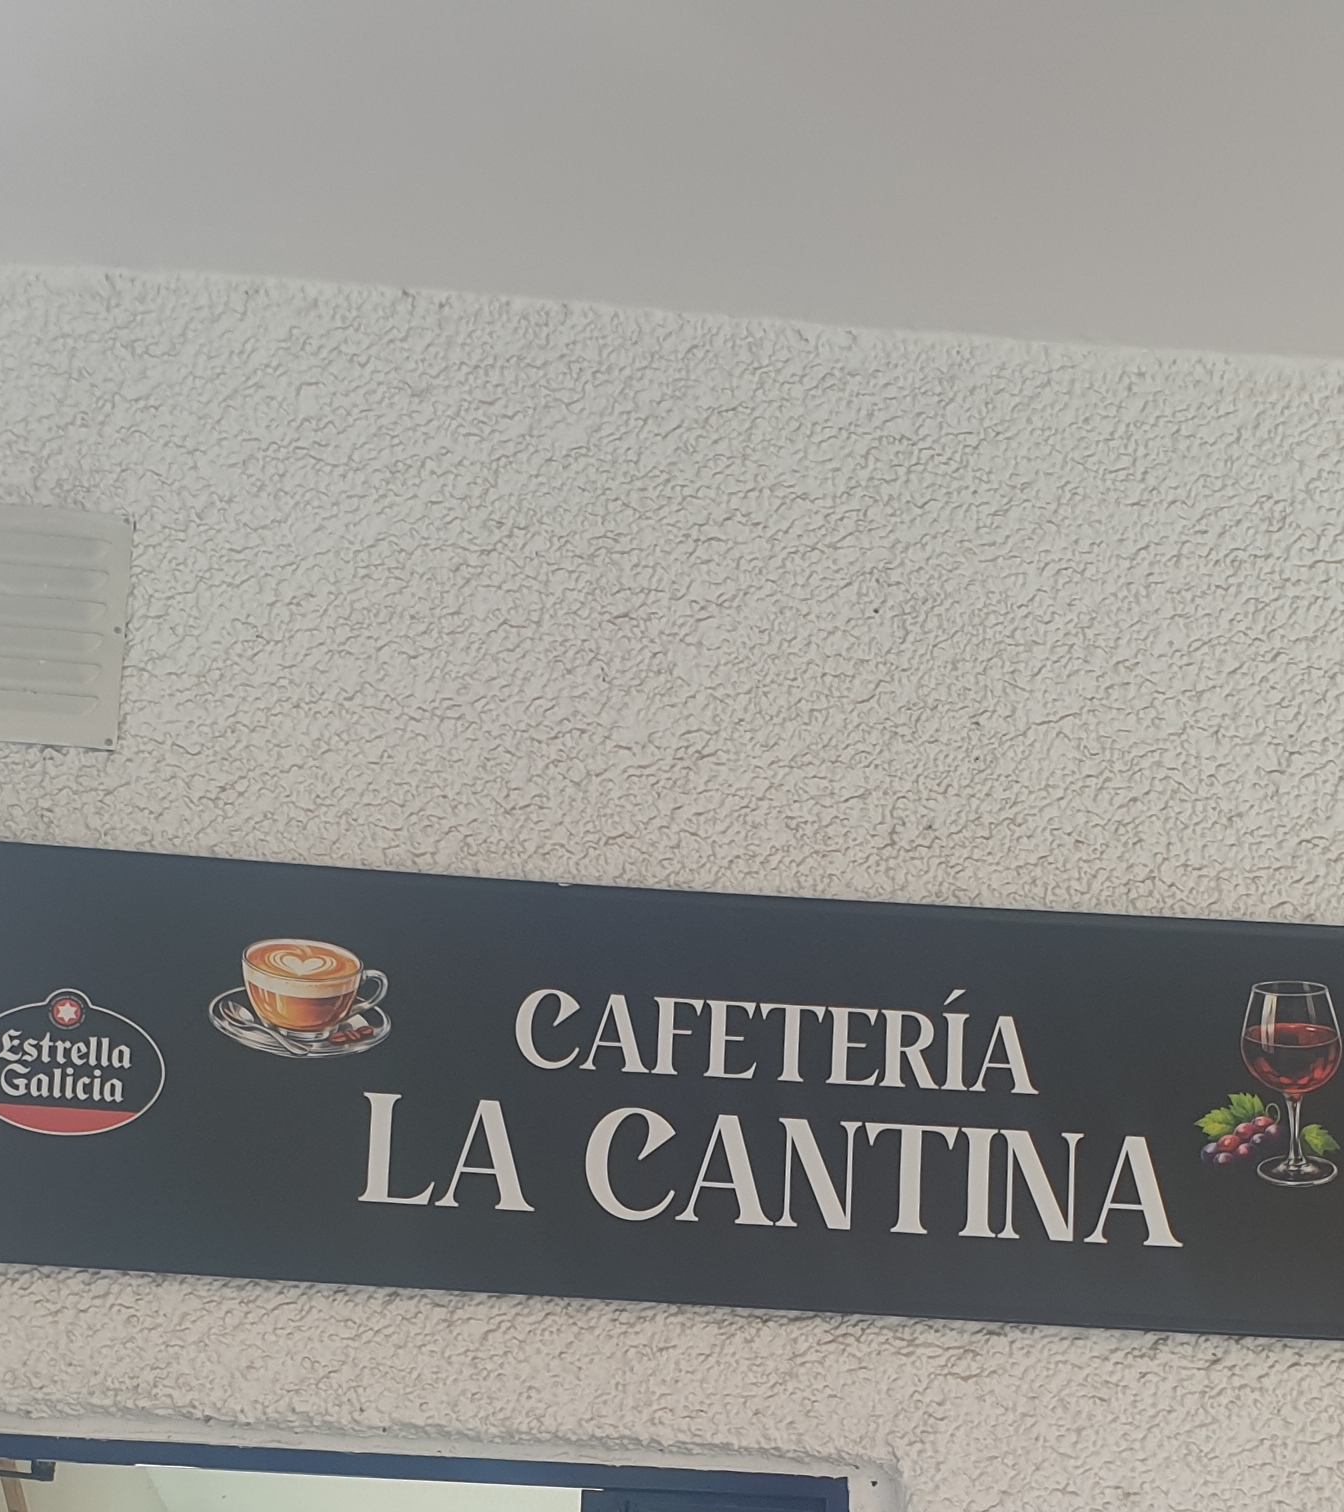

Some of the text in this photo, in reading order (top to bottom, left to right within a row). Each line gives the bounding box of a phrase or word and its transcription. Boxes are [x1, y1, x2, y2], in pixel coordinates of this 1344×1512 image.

[0, 1062, 124, 1103] Galicia
[515, 988, 1039, 1095] CAFETERÍA
[357, 1092, 1183, 1248] LA CANTINA
